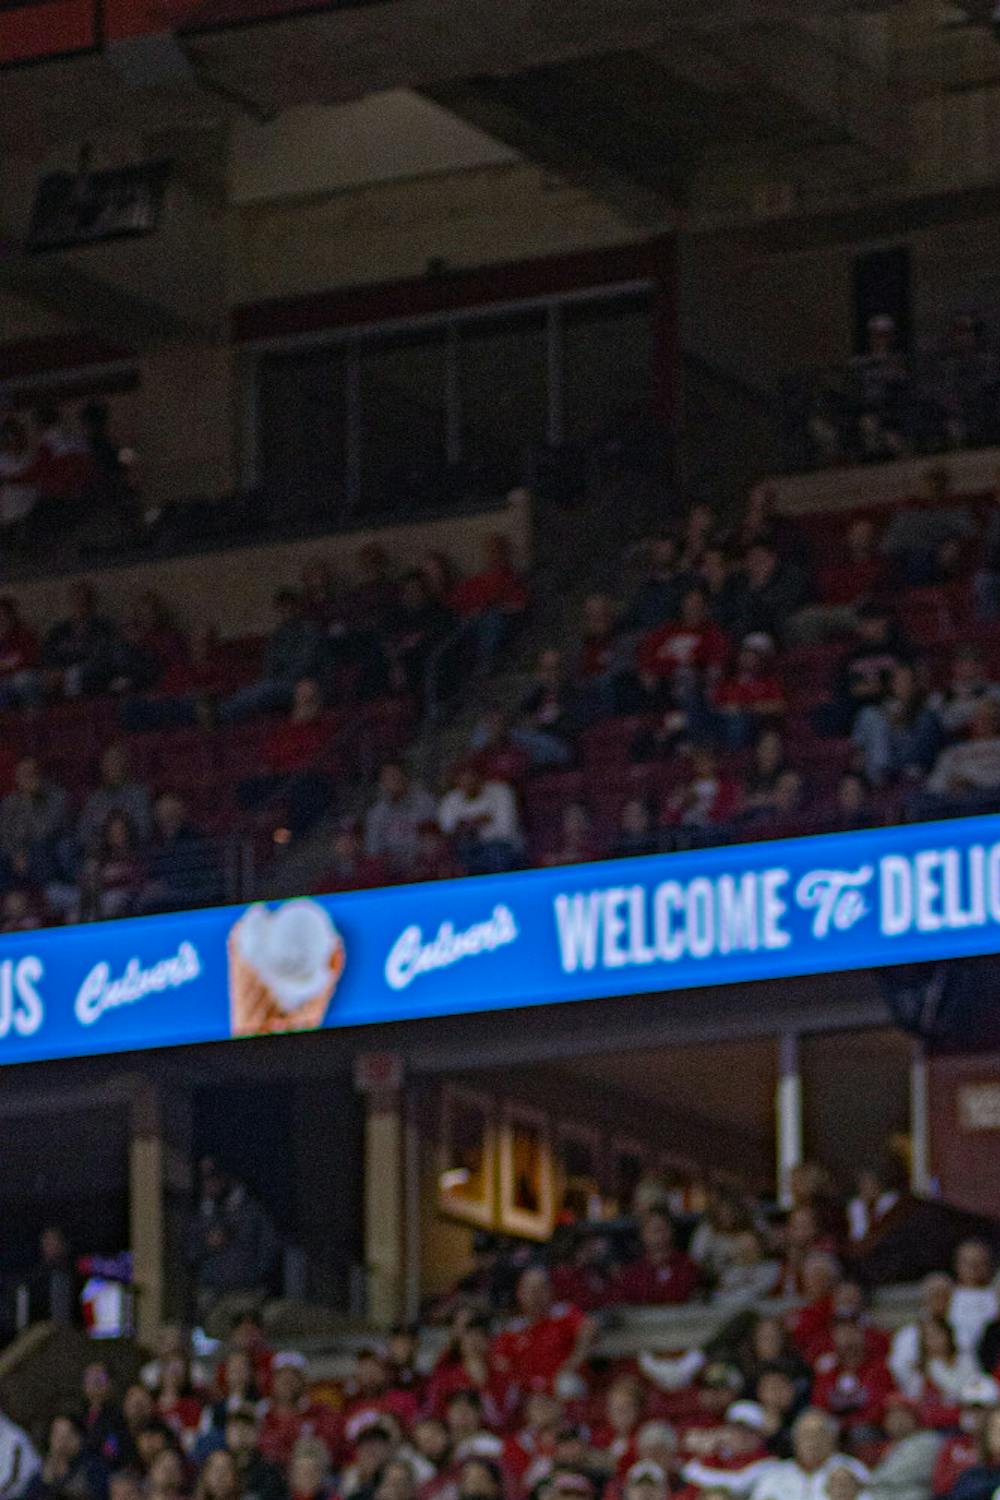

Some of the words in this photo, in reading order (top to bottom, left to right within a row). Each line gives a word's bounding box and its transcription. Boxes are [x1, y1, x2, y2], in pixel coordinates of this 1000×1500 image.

[384, 902, 518, 991] Culver's
[554, 866, 791, 974] WELCOME
[796, 864, 875, 939] To
[74, 939, 202, 1027] Culver's
